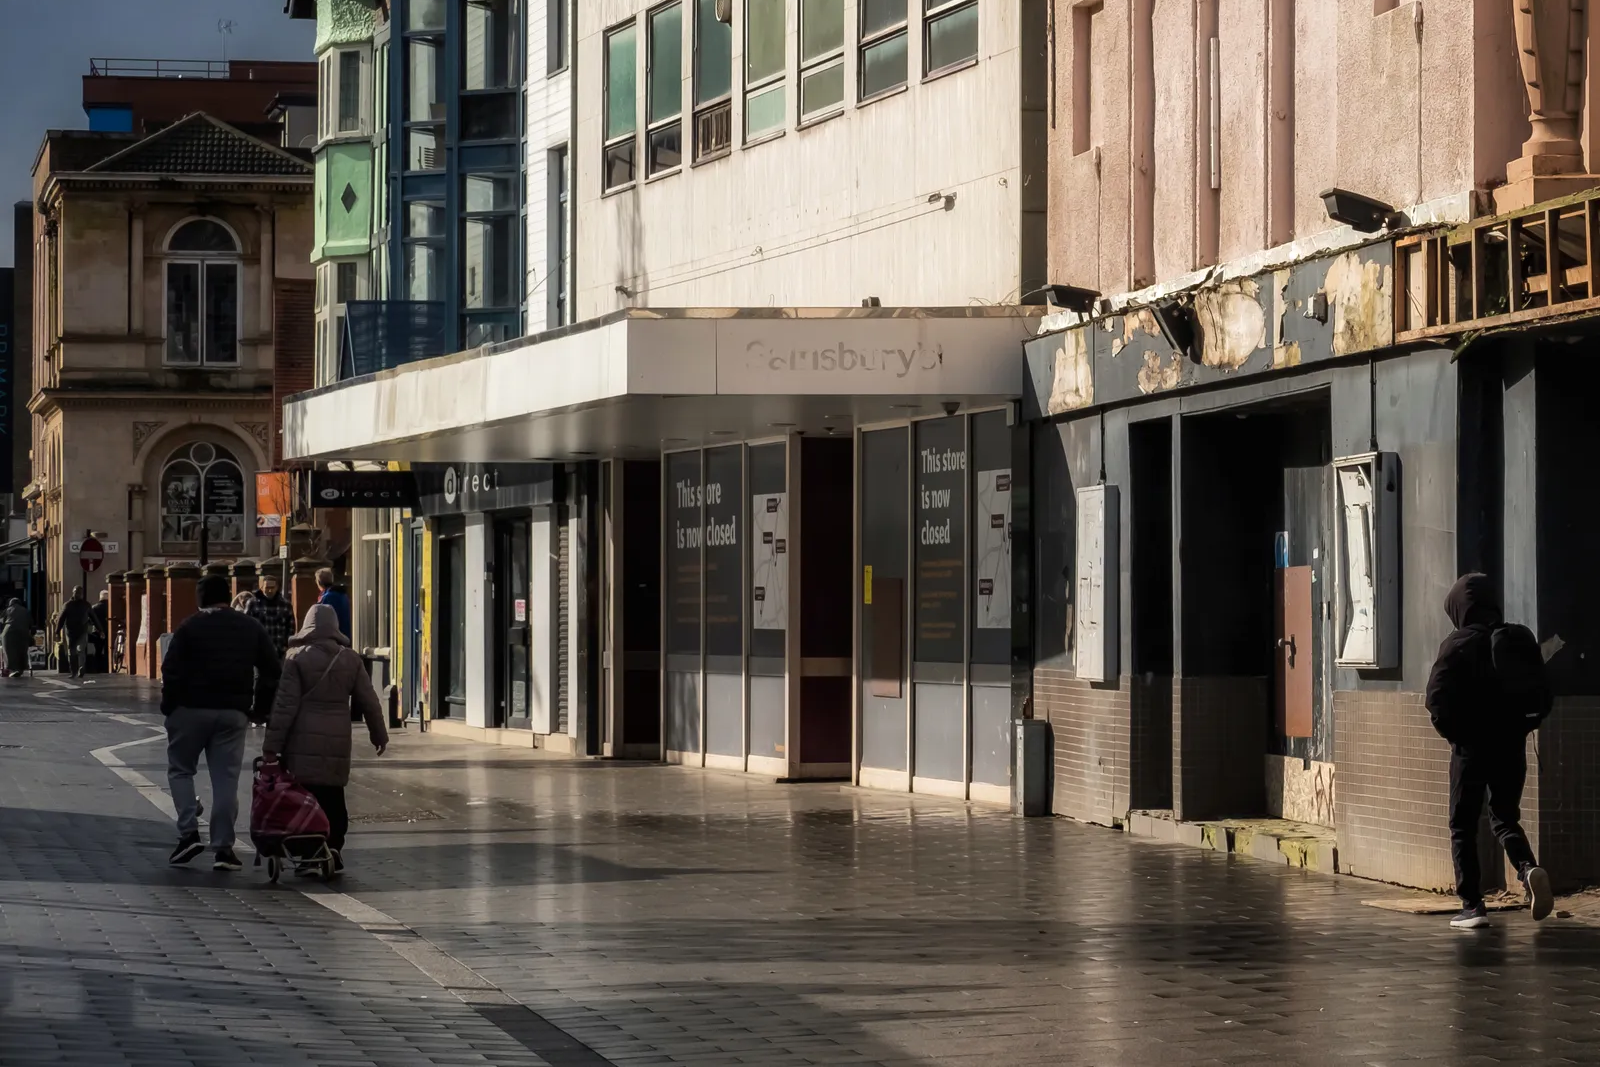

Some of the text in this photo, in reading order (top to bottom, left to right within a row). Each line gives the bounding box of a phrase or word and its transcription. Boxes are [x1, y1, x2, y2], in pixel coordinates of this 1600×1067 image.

[921, 447, 965, 473] This store
[320, 488, 402, 500] direct
[444, 466, 499, 504] direct
[676, 478, 721, 508] This sore
[921, 484, 950, 509] is now
[676, 520, 685, 549] is
[706, 515, 736, 546] closed
[921, 518, 950, 545] closed
